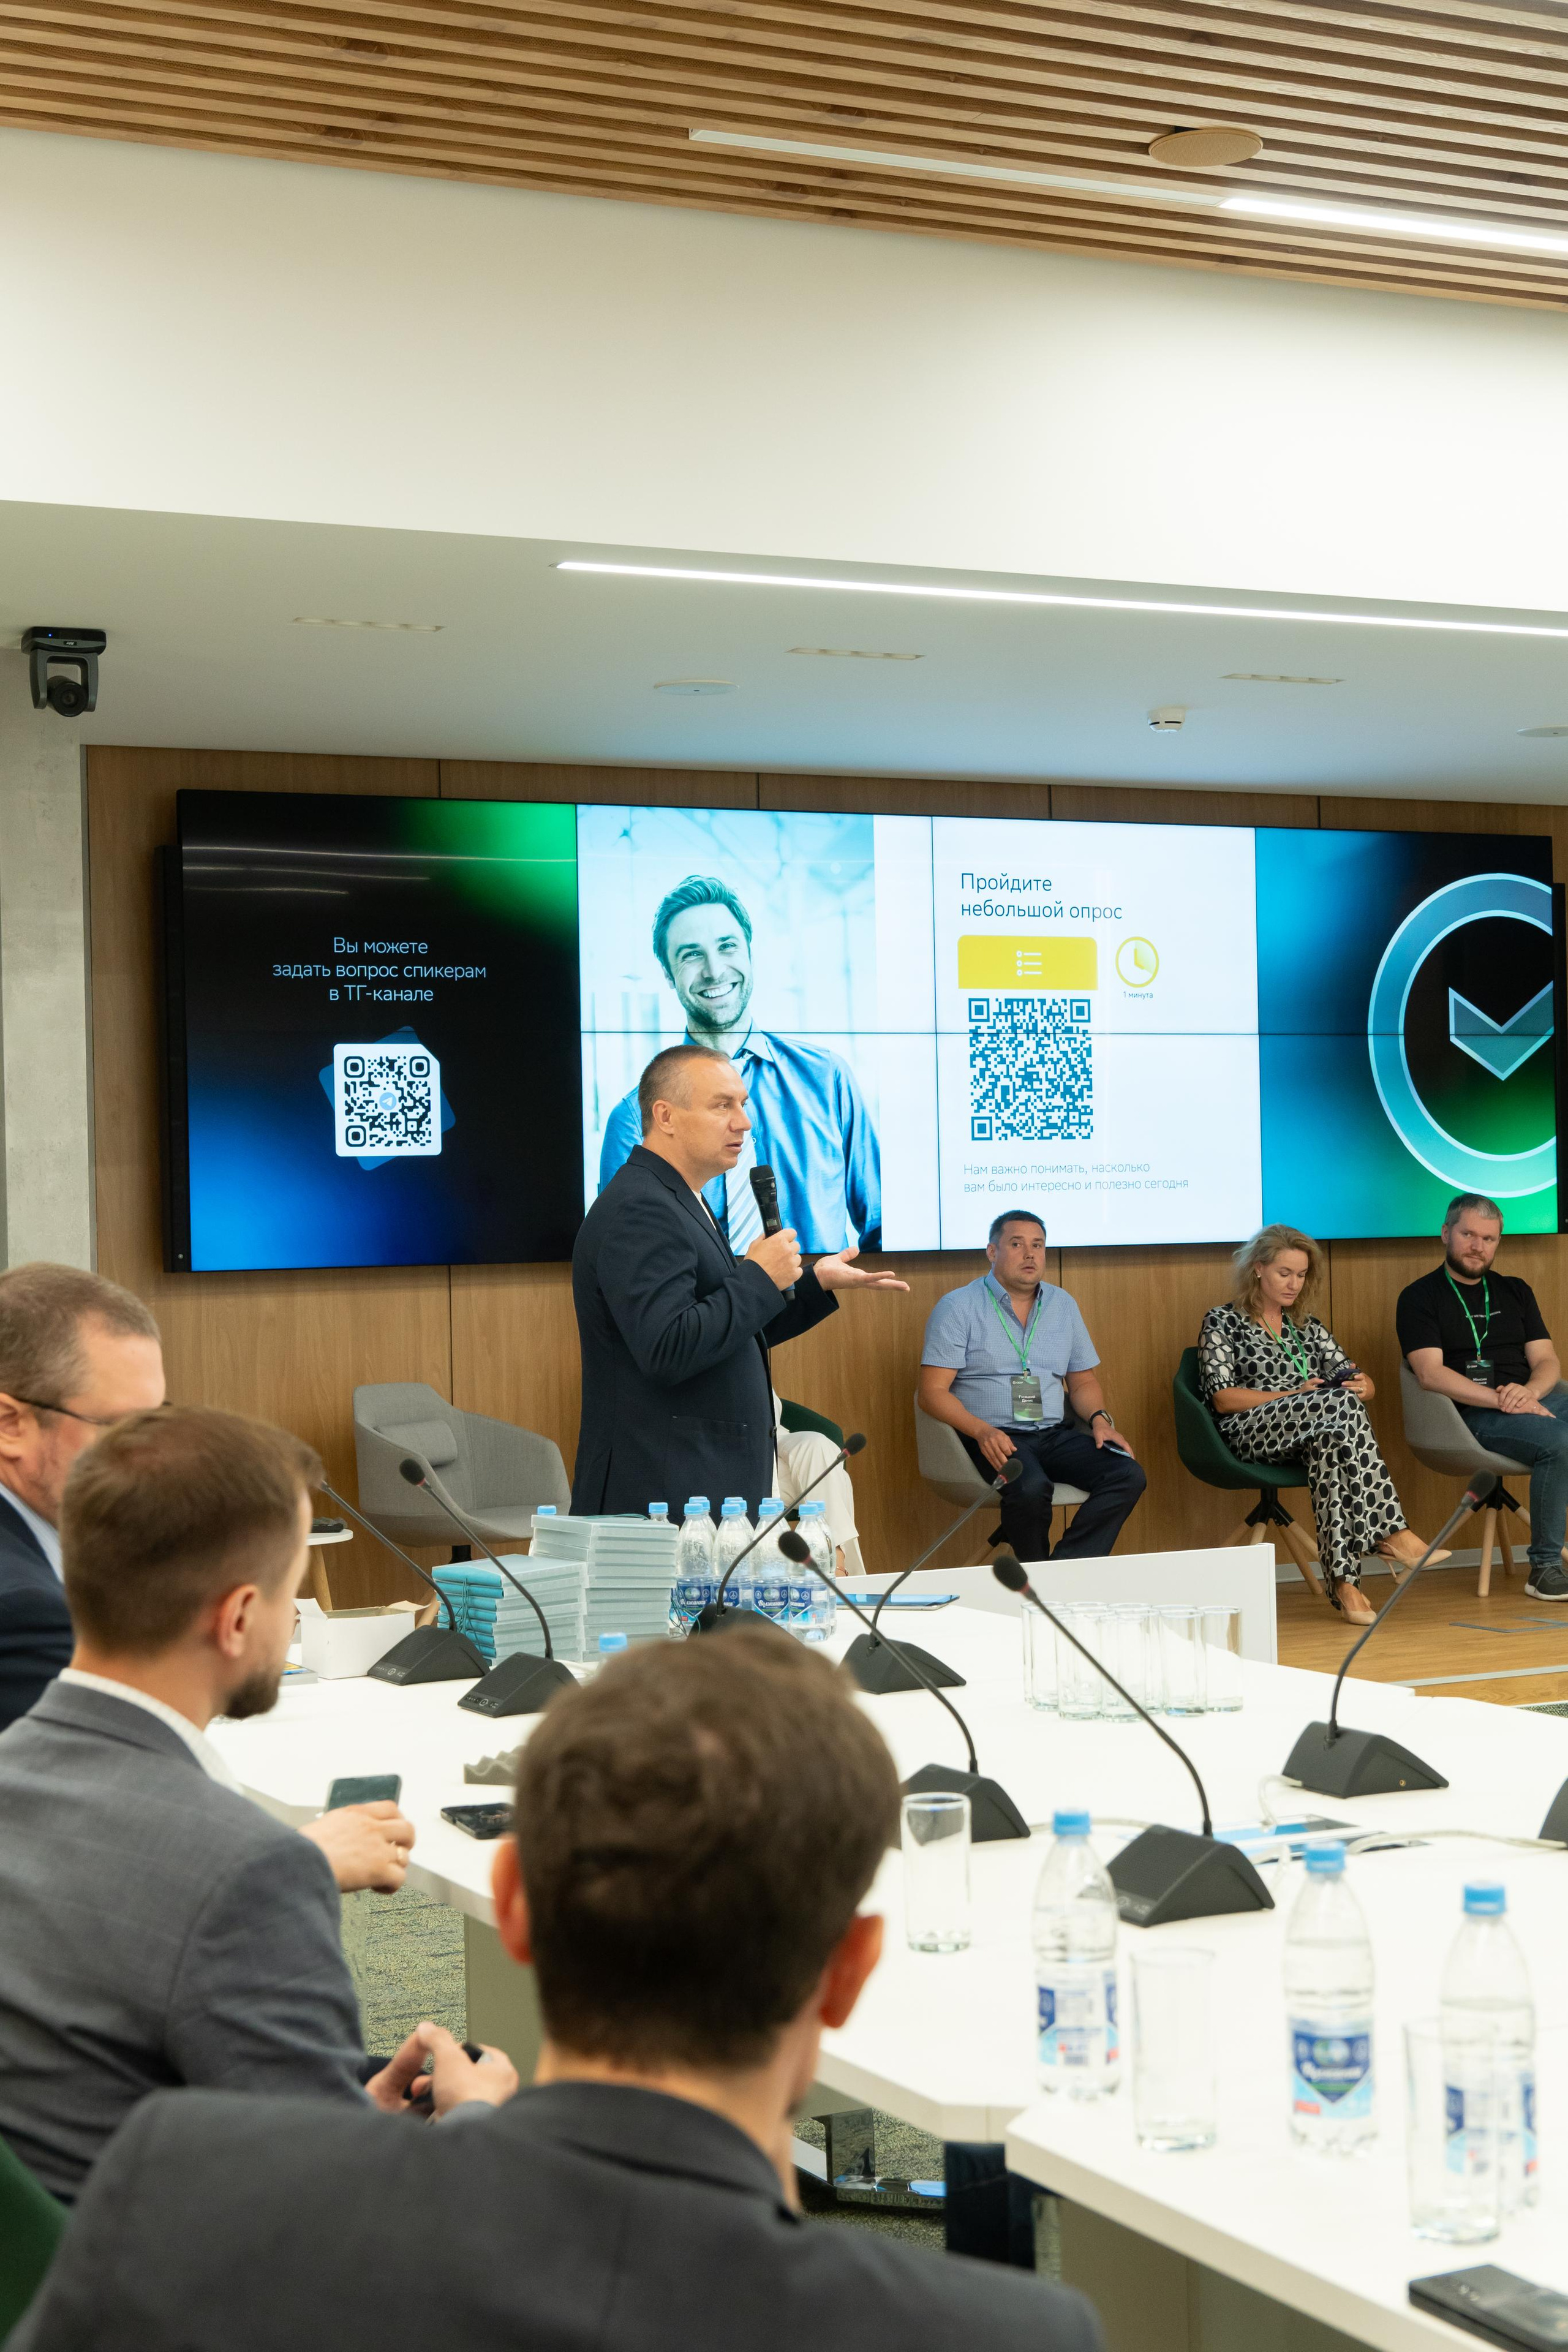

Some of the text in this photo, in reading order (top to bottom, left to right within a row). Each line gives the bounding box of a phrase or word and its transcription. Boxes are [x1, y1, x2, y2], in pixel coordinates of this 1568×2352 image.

[961, 873, 1052, 893] Пройдите
[962, 899, 1122, 922] небольшой опрос
[334, 937, 428, 954] Вы можете
[273, 965, 486, 981] задать вопрос спикерам
[330, 985, 433, 1001] в ТГ-канале
[964, 1164, 1151, 1175] Нам важно понимать, насколько
[989, 1180, 1017, 1192] было
[1021, 1182, 1081, 1193] интересно
[1095, 1180, 1142, 1189] полезно
[1145, 1180, 1188, 1189] сегодня
